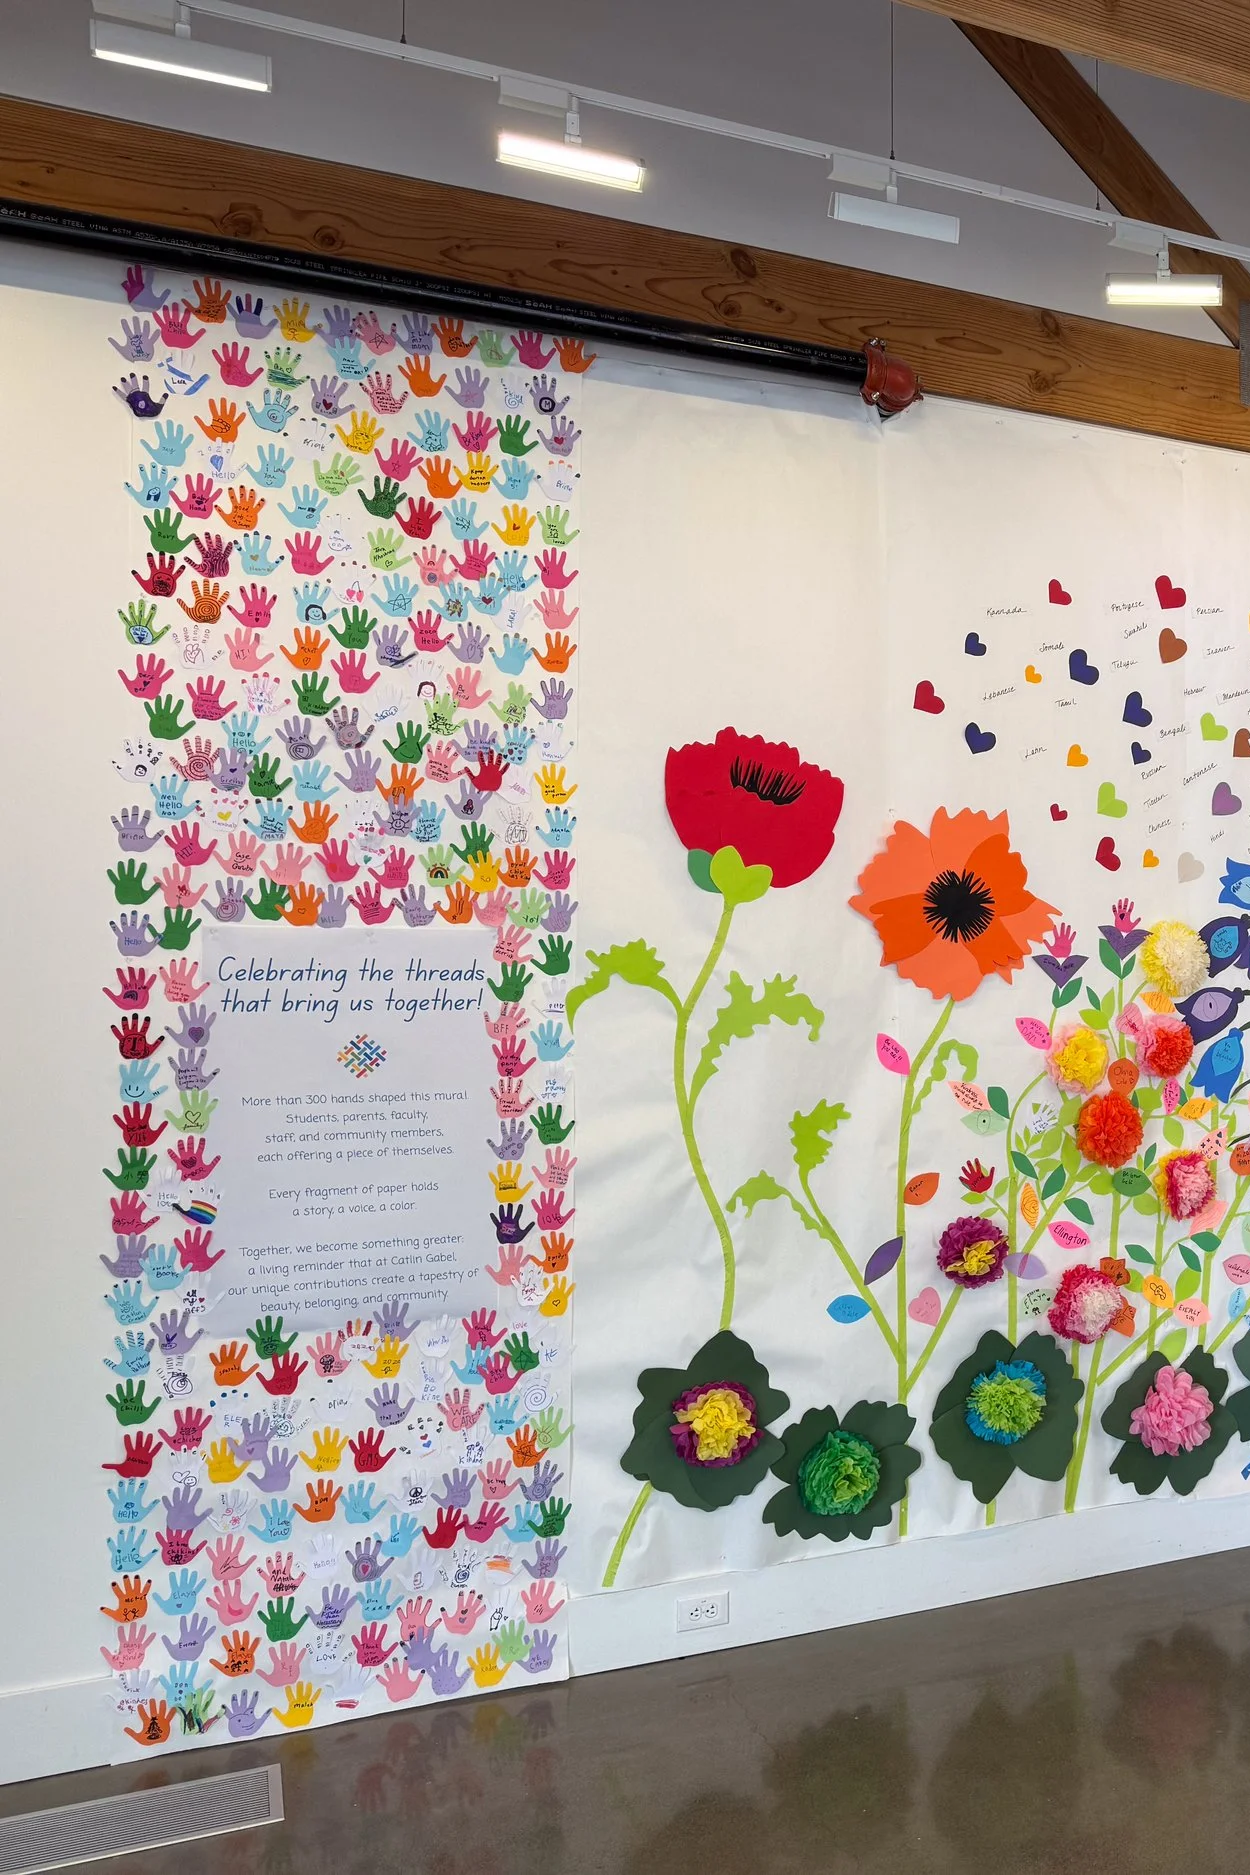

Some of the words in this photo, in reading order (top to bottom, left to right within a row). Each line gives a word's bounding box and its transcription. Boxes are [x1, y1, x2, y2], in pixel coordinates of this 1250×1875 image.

[987, 606, 1027, 617] Kannada
[159, 801, 183, 809] Hello
[218, 956, 347, 994] Celebrating
[359, 958, 393, 981] the
[405, 958, 485, 981] threads
[221, 988, 271, 1012] that
[282, 989, 340, 1023] bring
[350, 1000, 373, 1011] us
[385, 988, 483, 1022] together!
[242, 1097, 271, 1106] More
[275, 1096, 302, 1105] than
[306, 1095, 327, 1104] 300
[331, 1094, 364, 1103] hands
[368, 1092, 406, 1105] shaped
[411, 1092, 430, 1101] this
[286, 1113, 339, 1123] Students,
[343, 1112, 386, 1125] parents,
[391, 1110, 428, 1123] faculty,
[265, 1133, 295, 1143] staff,
[299, 1132, 319, 1141] and
[324, 1130, 387, 1143] community
[391, 1128, 443, 1138] members,
[258, 1152, 283, 1162] each
[287, 1151, 332, 1163] offering
[347, 1150, 373, 1162] piece
[377, 1147, 389, 1156] of
[392, 1145, 454, 1156] themselves.
[269, 1189, 300, 1202] Every
[305, 1186, 358, 1200] fragment
[362, 1184, 374, 1194] of
[377, 1185, 407, 1196] paper
[412, 1182, 439, 1191] holds
[304, 1206, 334, 1219] story,
[349, 1204, 376, 1212] voice,
[390, 1201, 417, 1210] color.
[1053, 1225, 1088, 1246] Ellington
[239, 1245, 292, 1260] Together,
[316, 1243, 358, 1252] become
[362, 1237, 419, 1249] something
[260, 1265, 289, 1277] living
[294, 1260, 344, 1272] reminder
[348, 1259, 372, 1268] that
[376, 1257, 387, 1266] at
[391, 1255, 422, 1265] Catlin
[426, 1252, 456, 1262] Gabel,
[228, 1287, 247, 1295] our
[252, 1284, 290, 1297] unique
[294, 1278, 367, 1290] contributions
[372, 1275, 404, 1284] create
[419, 1271, 464, 1284] tapestry
[468, 1268, 479, 1277] of
[261, 1301, 300, 1314] beauty,
[363, 1293, 382, 1303] and
[450, 1405, 469, 1416] WE
[452, 1414, 478, 1430] CARE
